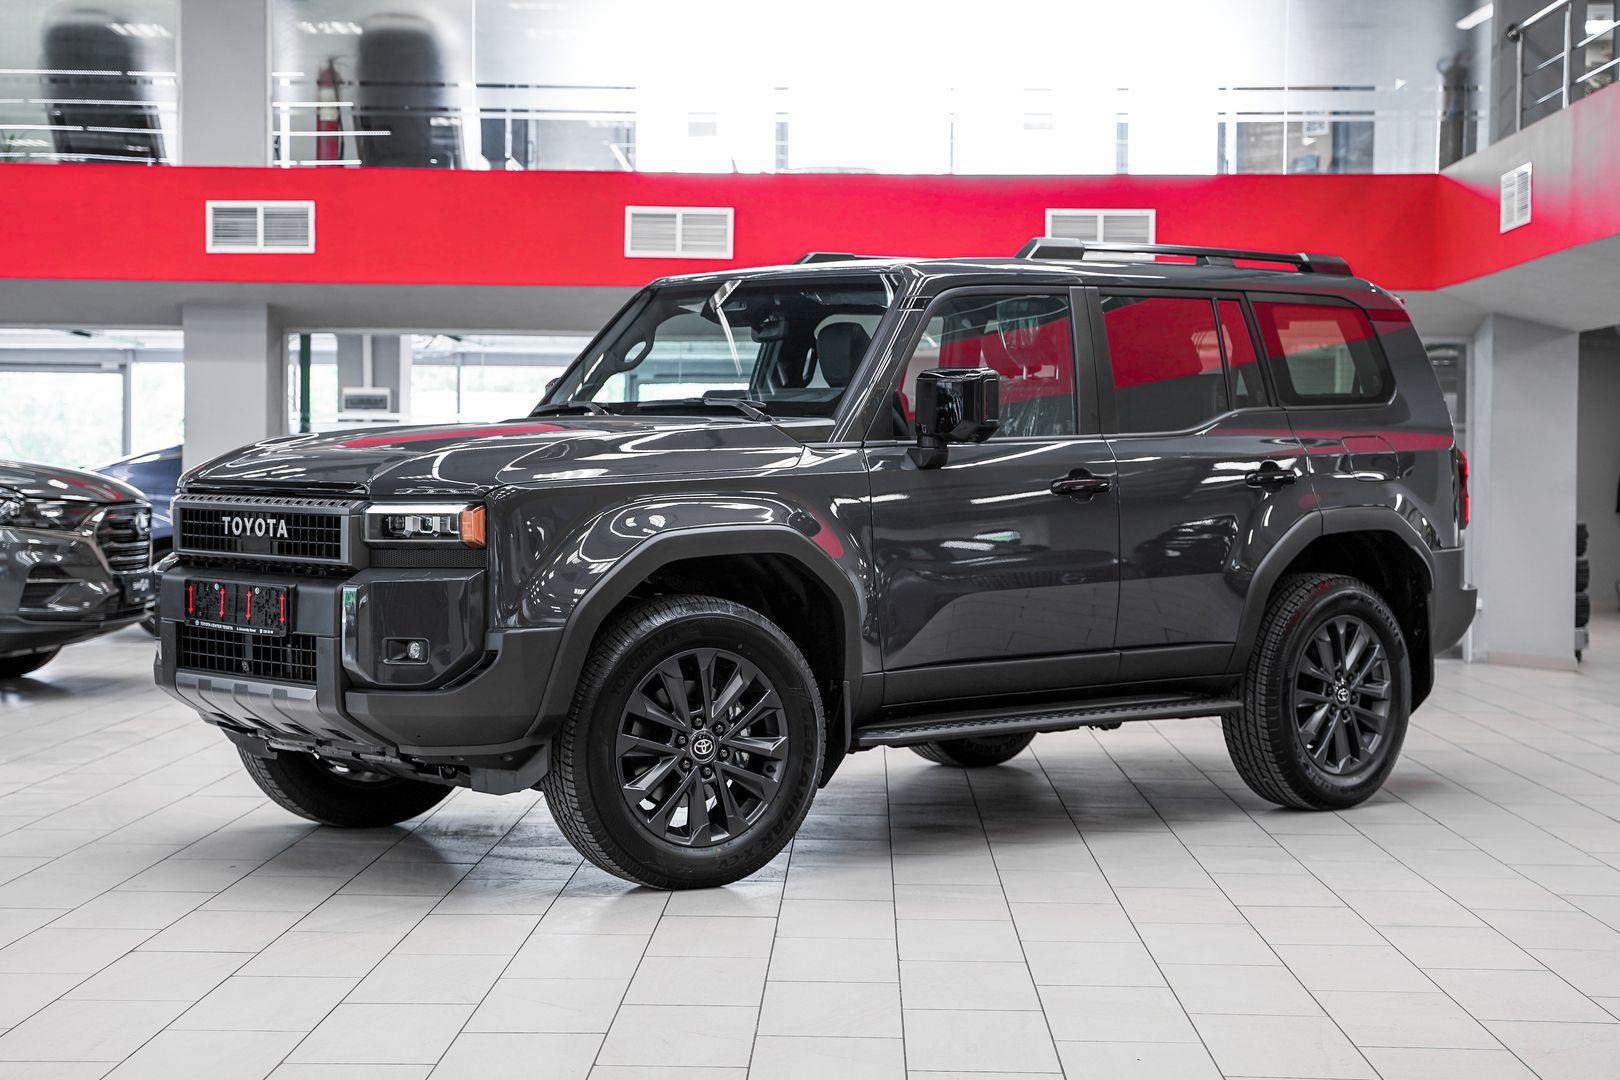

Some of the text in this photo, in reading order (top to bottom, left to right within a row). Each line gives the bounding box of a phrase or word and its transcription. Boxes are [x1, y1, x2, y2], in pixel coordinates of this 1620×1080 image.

[221, 516, 288, 538] TOYOTA
[611, 631, 682, 695] YOKOHAMA
[761, 708, 815, 849] GEOLANDAR
